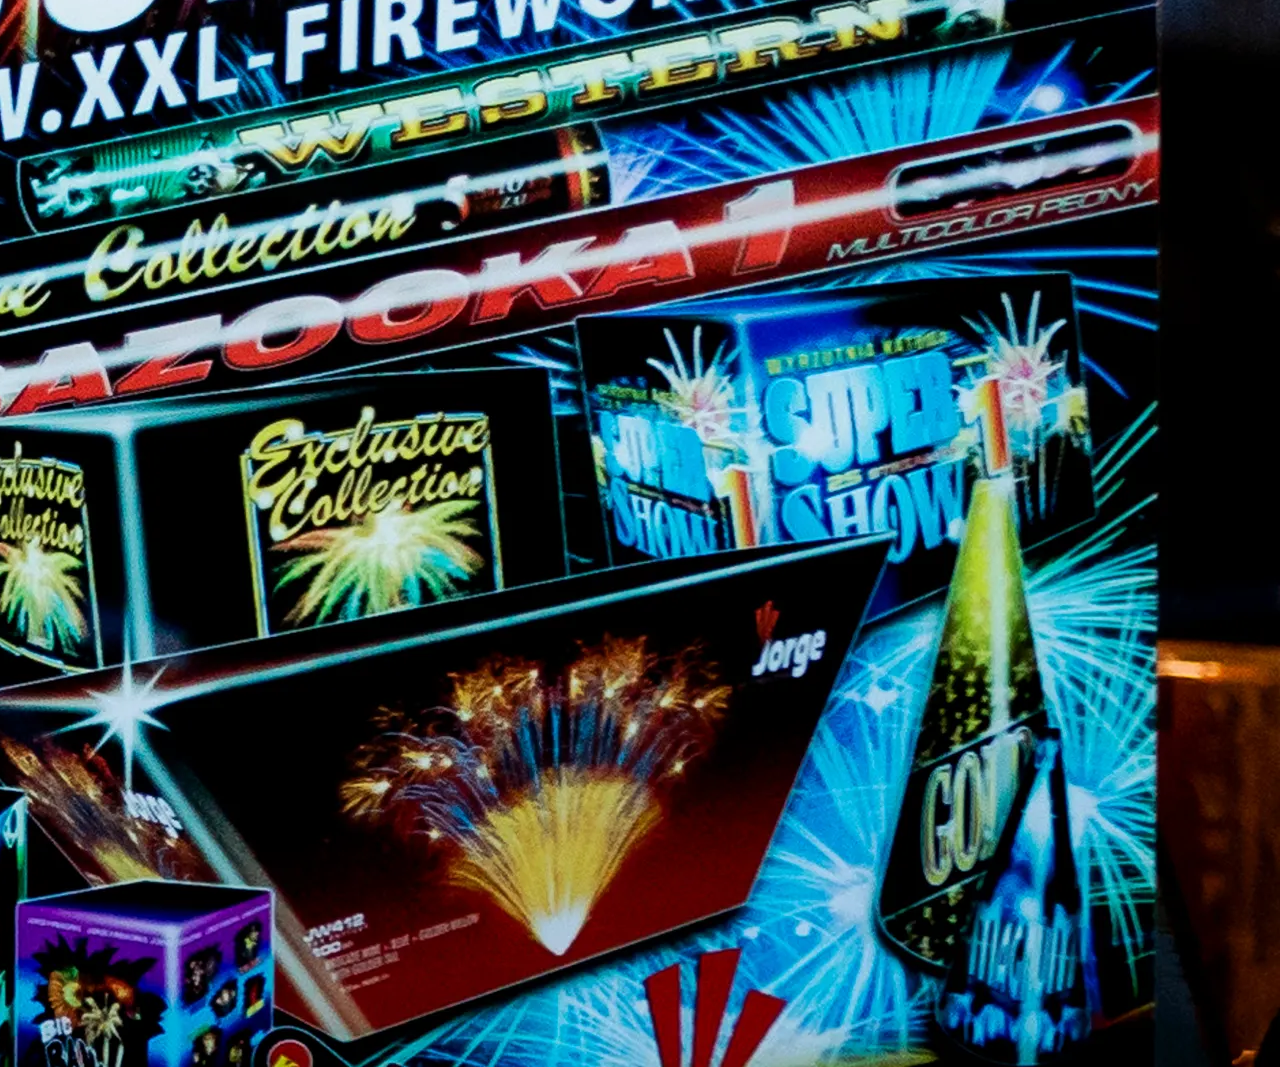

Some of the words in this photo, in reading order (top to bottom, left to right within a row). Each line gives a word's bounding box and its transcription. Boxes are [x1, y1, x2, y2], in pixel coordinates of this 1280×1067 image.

[84, 198, 417, 301] Collection
[721, 179, 796, 276] 1
[826, 203, 1036, 261] MULTICOLOR
[1038, 178, 1155, 217] PEONY
[248, 407, 490, 495] Exclusive
[762, 351, 961, 486] SUPER
[272, 460, 484, 541] Collection
[780, 460, 966, 565] SHOW
[752, 630, 827, 679] Jorge
